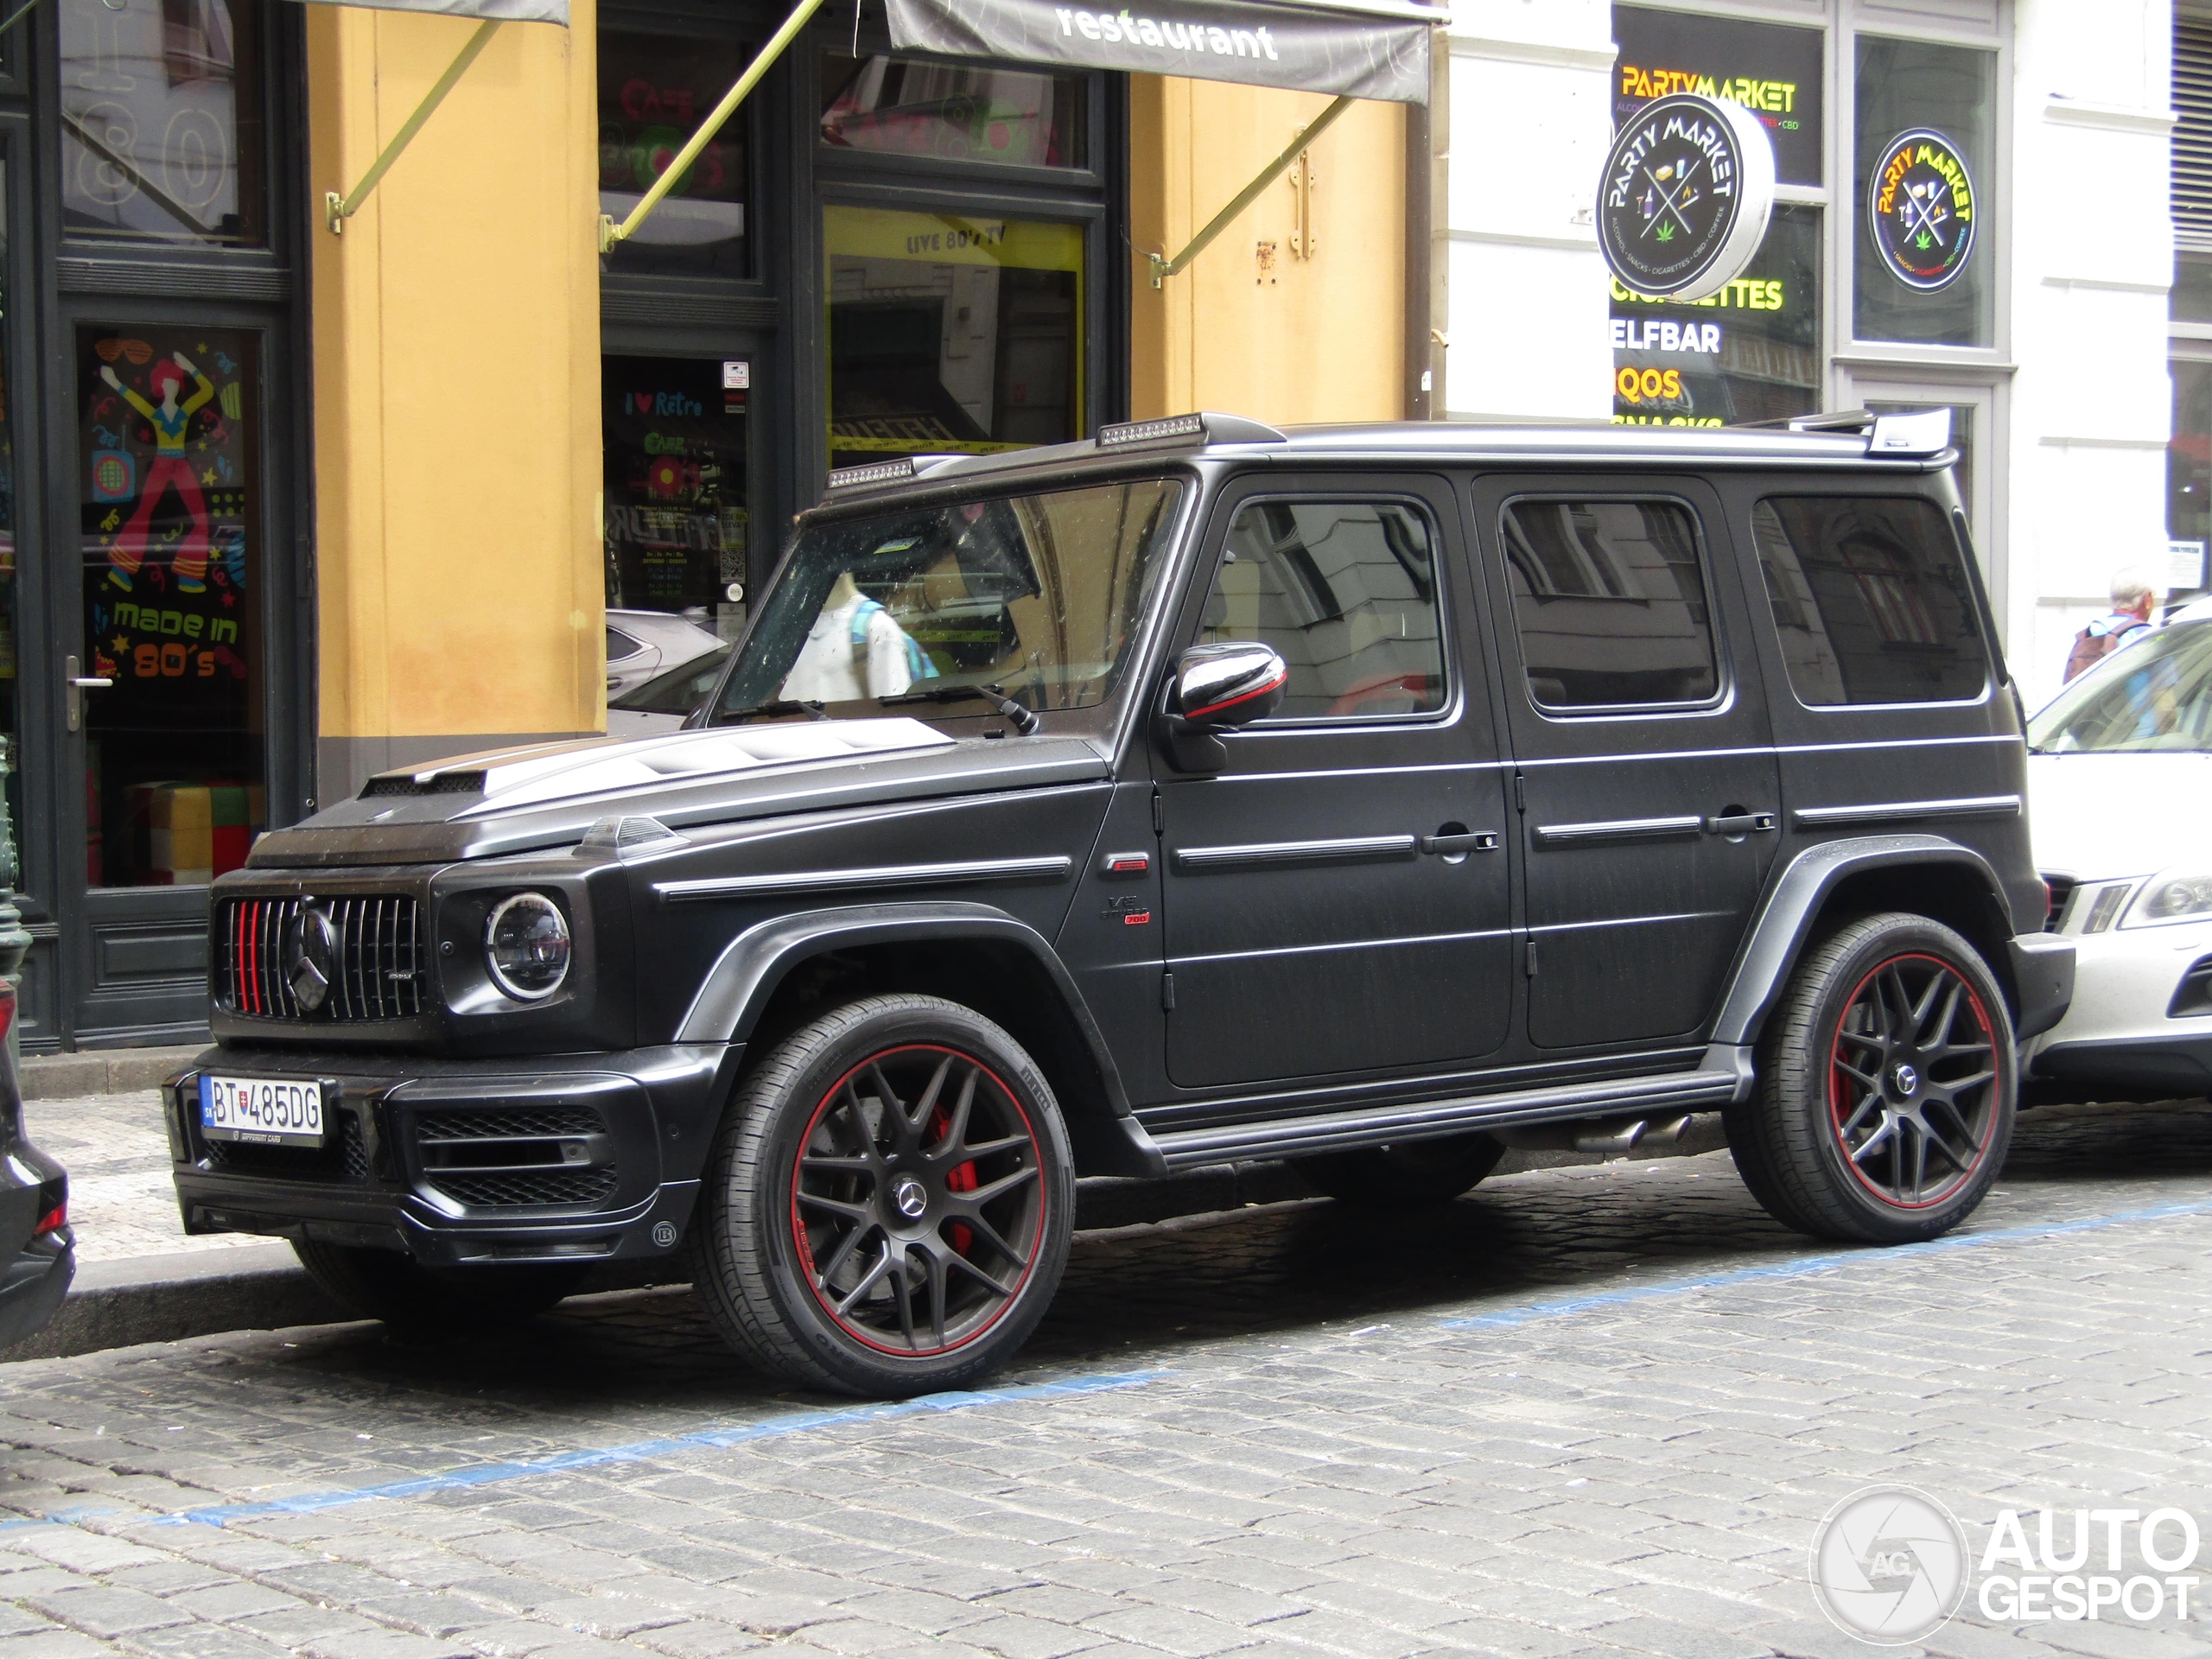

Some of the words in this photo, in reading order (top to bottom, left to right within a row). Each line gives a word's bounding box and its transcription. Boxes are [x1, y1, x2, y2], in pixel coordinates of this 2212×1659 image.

[1054, 7, 1279, 61] restaurant
[1782, 120, 1799, 130] CBD
[1609, 124, 1656, 207] PARTY
[1662, 116, 1732, 197] MARKET
[1878, 146, 1913, 214] PARTY
[1915, 144, 1971, 222] MARKET
[907, 232, 940, 254] LIVE
[946, 229, 981, 251] 80's
[985, 225, 1006, 245] TV
[1611, 217, 1626, 254] ALCOHOL
[1626, 253, 1649, 274] SNACKS
[1651, 257, 1690, 275] CIGARETTES
[1693, 242, 1707, 258] CBD
[1707, 206, 1726, 239] COFFEE
[1609, 319, 1719, 353] ELFBAR
[655, 391, 702, 416] Retro
